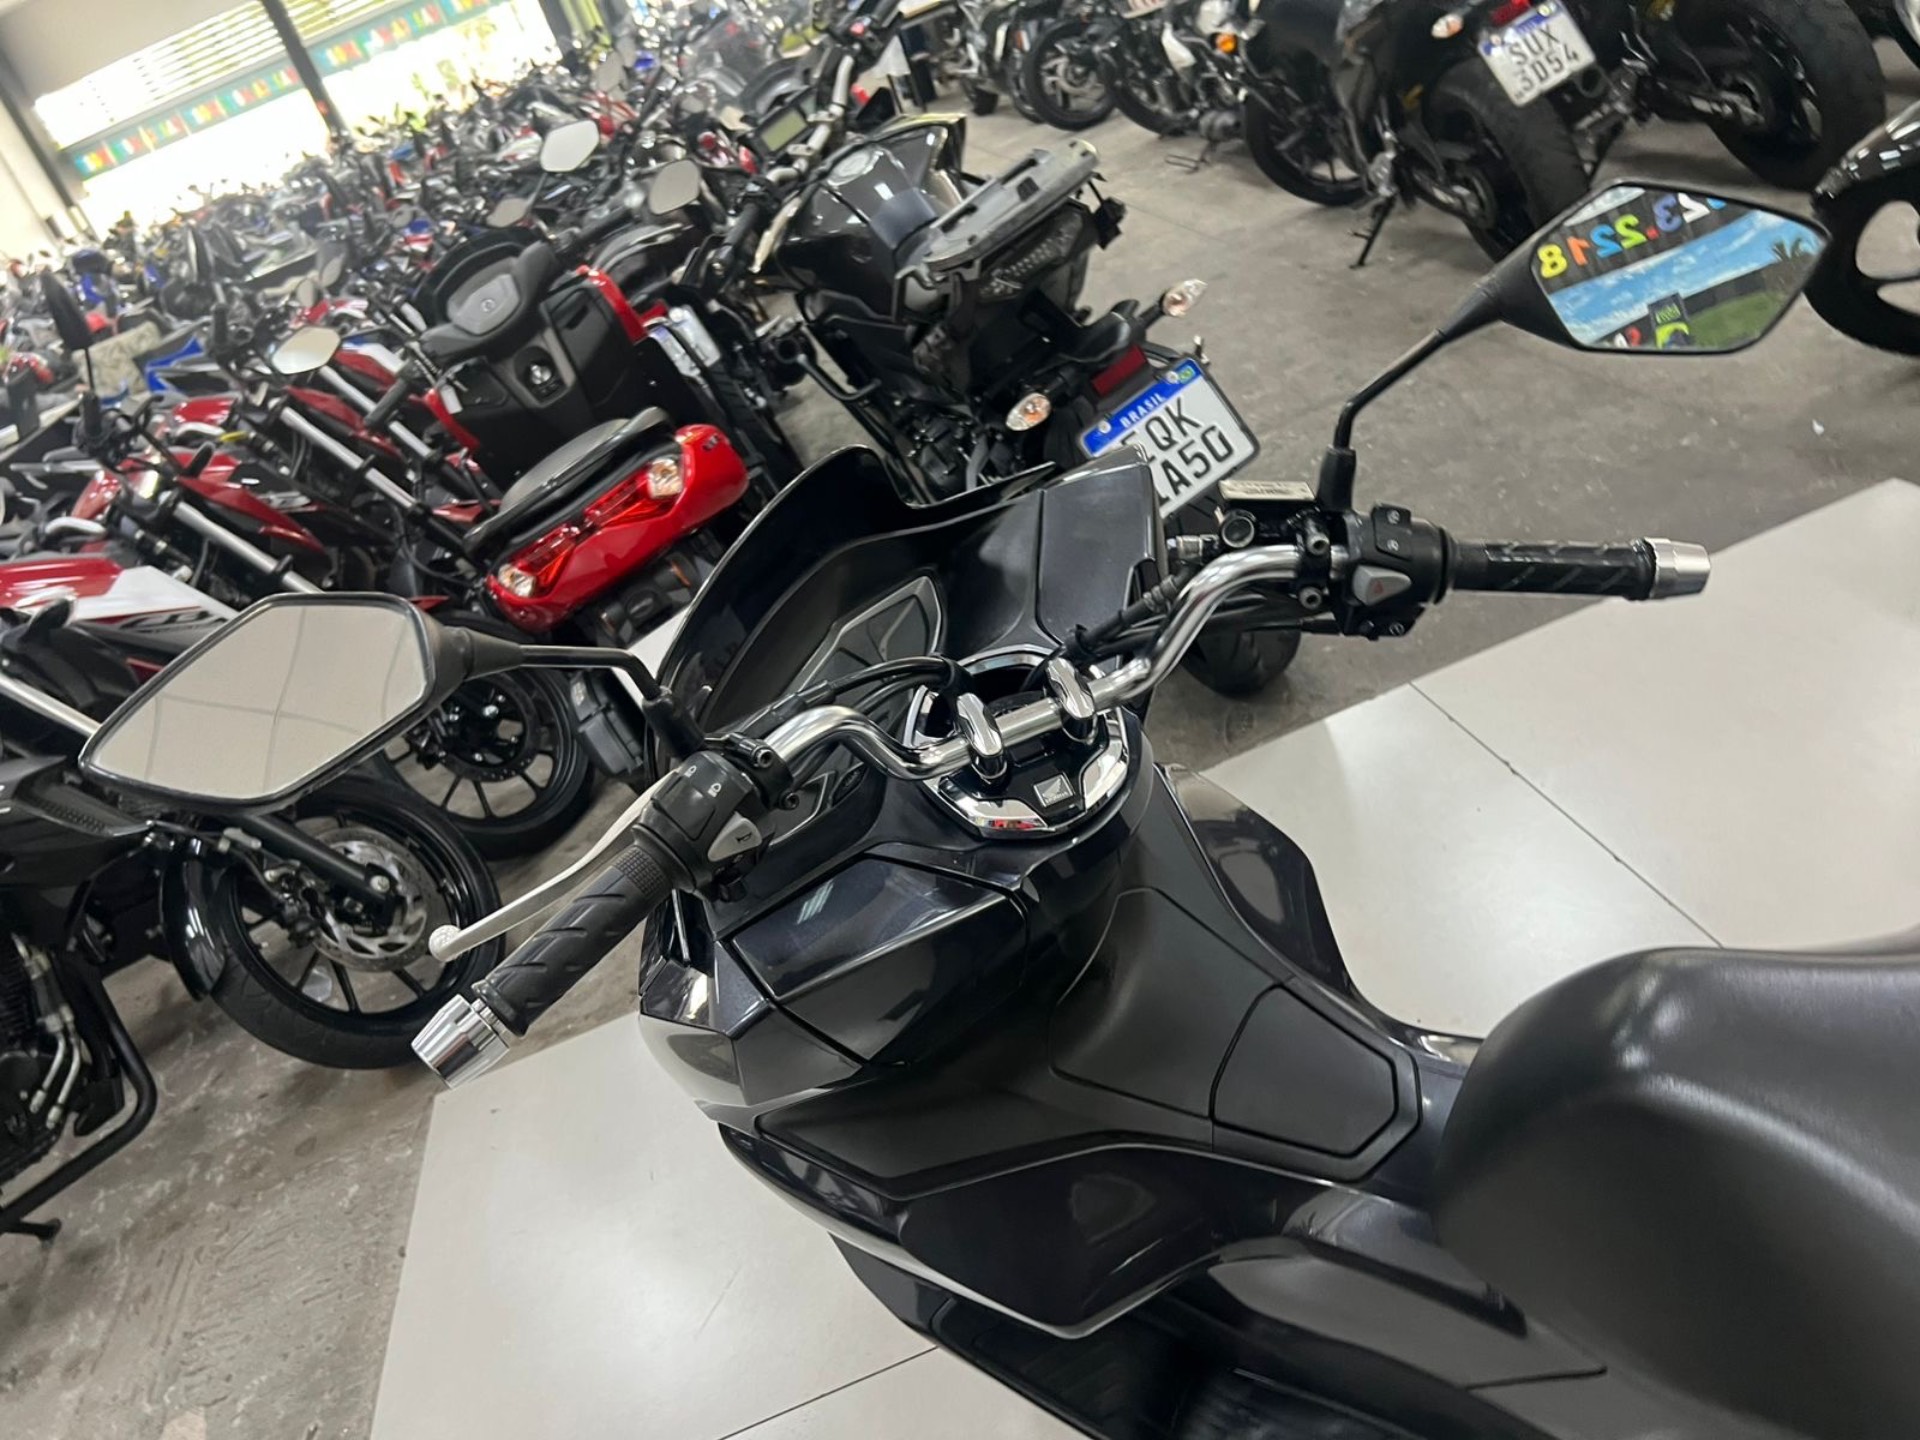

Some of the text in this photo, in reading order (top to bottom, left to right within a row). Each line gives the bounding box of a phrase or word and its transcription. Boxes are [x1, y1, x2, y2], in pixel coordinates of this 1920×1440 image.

[1508, 24, 1561, 65] SUX
[1513, 43, 1579, 92] 3D54
[1119, 392, 1166, 429] BRASIL
[1150, 425, 1234, 505] A50
